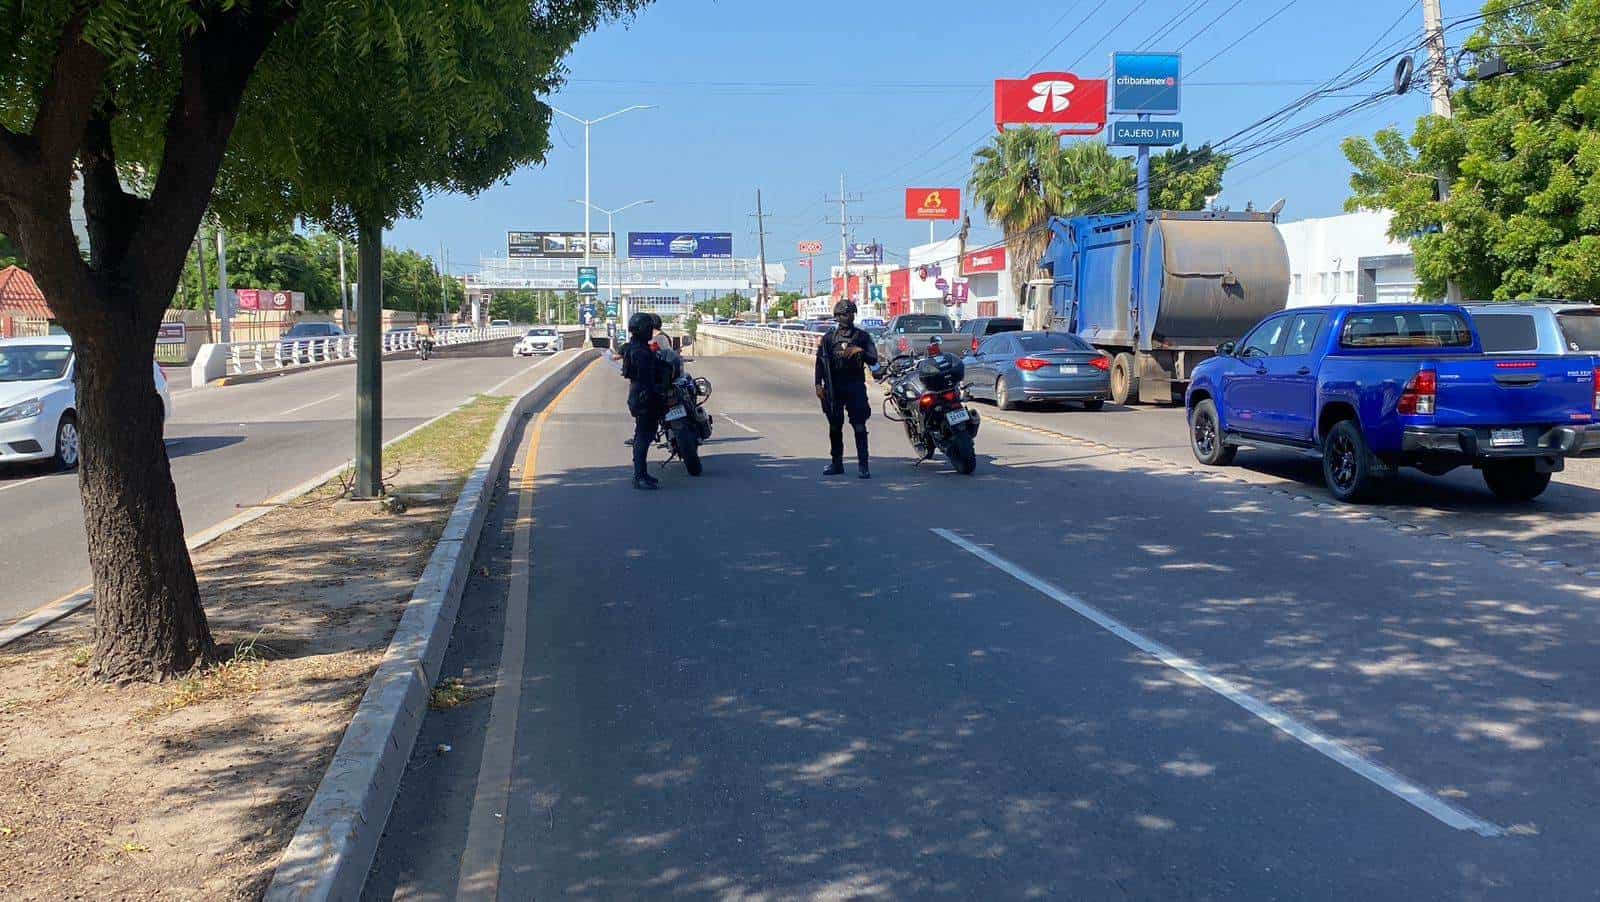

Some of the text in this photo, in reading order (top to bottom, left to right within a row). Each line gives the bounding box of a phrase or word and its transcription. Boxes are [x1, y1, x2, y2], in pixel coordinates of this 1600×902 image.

[1117, 75, 1165, 86] citibanamex
[1118, 128, 1180, 138] CAJERO ATM
